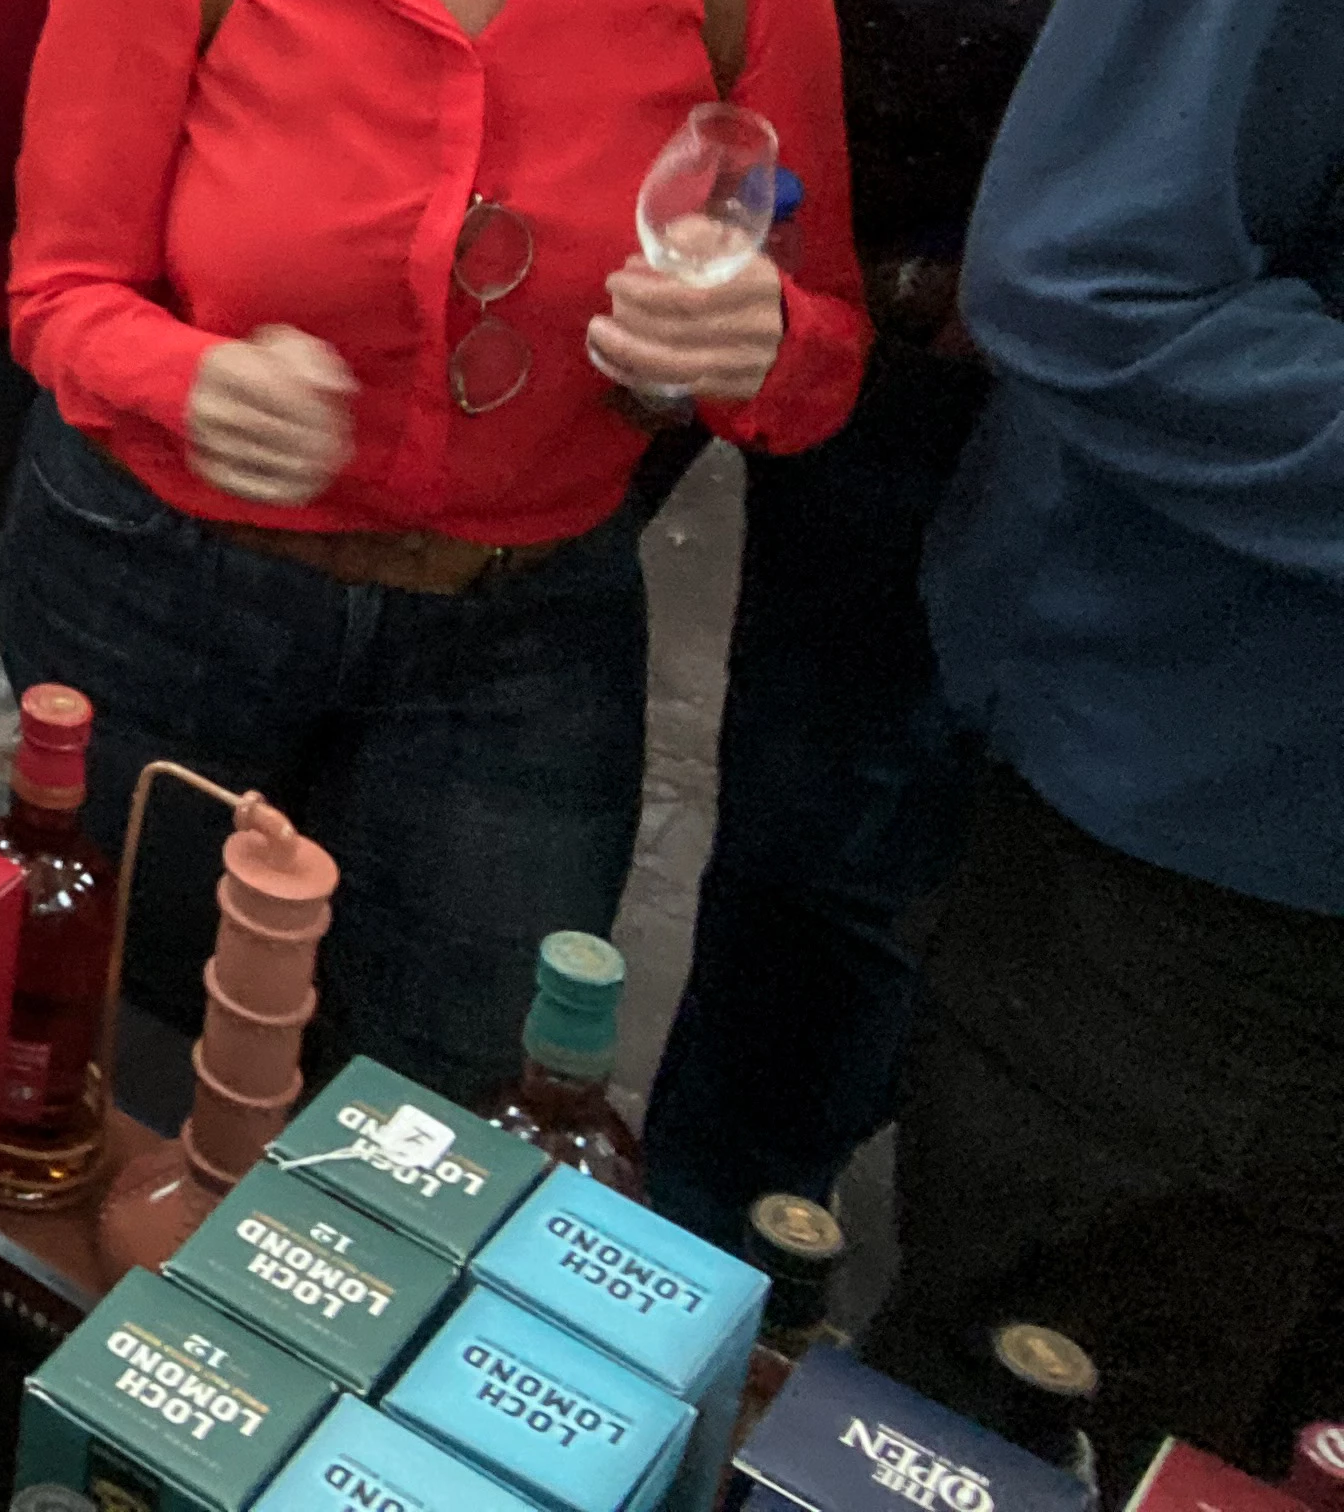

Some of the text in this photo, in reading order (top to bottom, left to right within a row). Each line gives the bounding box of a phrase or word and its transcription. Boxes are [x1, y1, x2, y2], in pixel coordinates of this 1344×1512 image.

[236, 1218, 392, 1316] LOMOND
[309, 1221, 355, 1254] 12
[546, 1216, 703, 1314] LOMOND
[247, 1252, 345, 1319] LOCH
[559, 1250, 657, 1315] LOCH
[107, 1331, 264, 1437] LOMOND
[183, 1333, 230, 1368] 12
[114, 1368, 216, 1440] LOCH
[462, 1344, 626, 1446] LOMOND
[476, 1381, 579, 1448] LOCH
[837, 1415, 995, 1512] OPEN
[870, 1461, 937, 1512] THE
